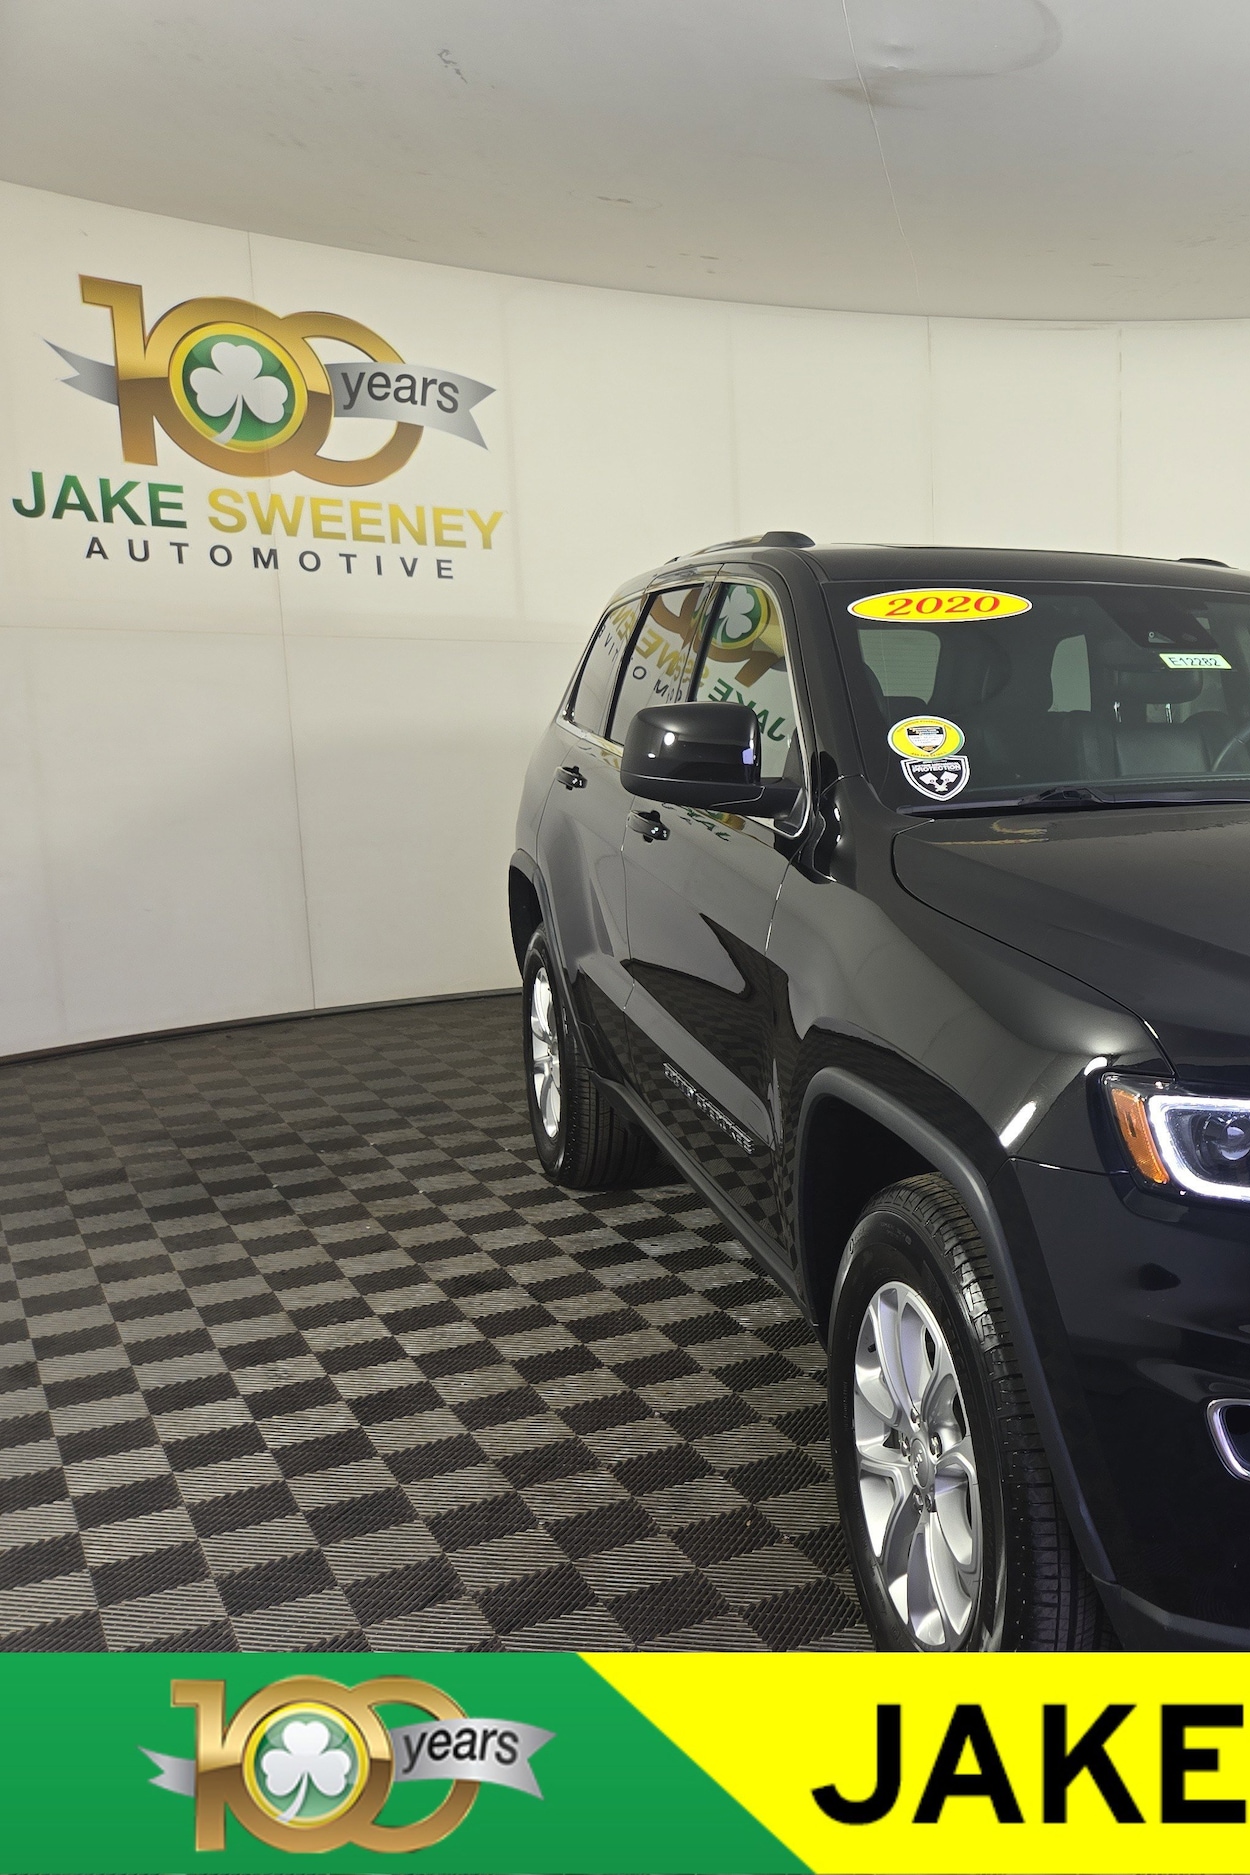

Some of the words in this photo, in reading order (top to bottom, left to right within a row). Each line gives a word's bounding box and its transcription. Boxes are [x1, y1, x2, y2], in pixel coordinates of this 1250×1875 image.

[78, 274, 424, 486] 100
[341, 370, 460, 413] years
[12, 471, 188, 528] JAKE
[208, 488, 503, 549] SWEENEY
[86, 536, 454, 578] AUTOMOTIVE
[885, 596, 1000, 616] 2020
[1168, 656, 1221, 667] E12282
